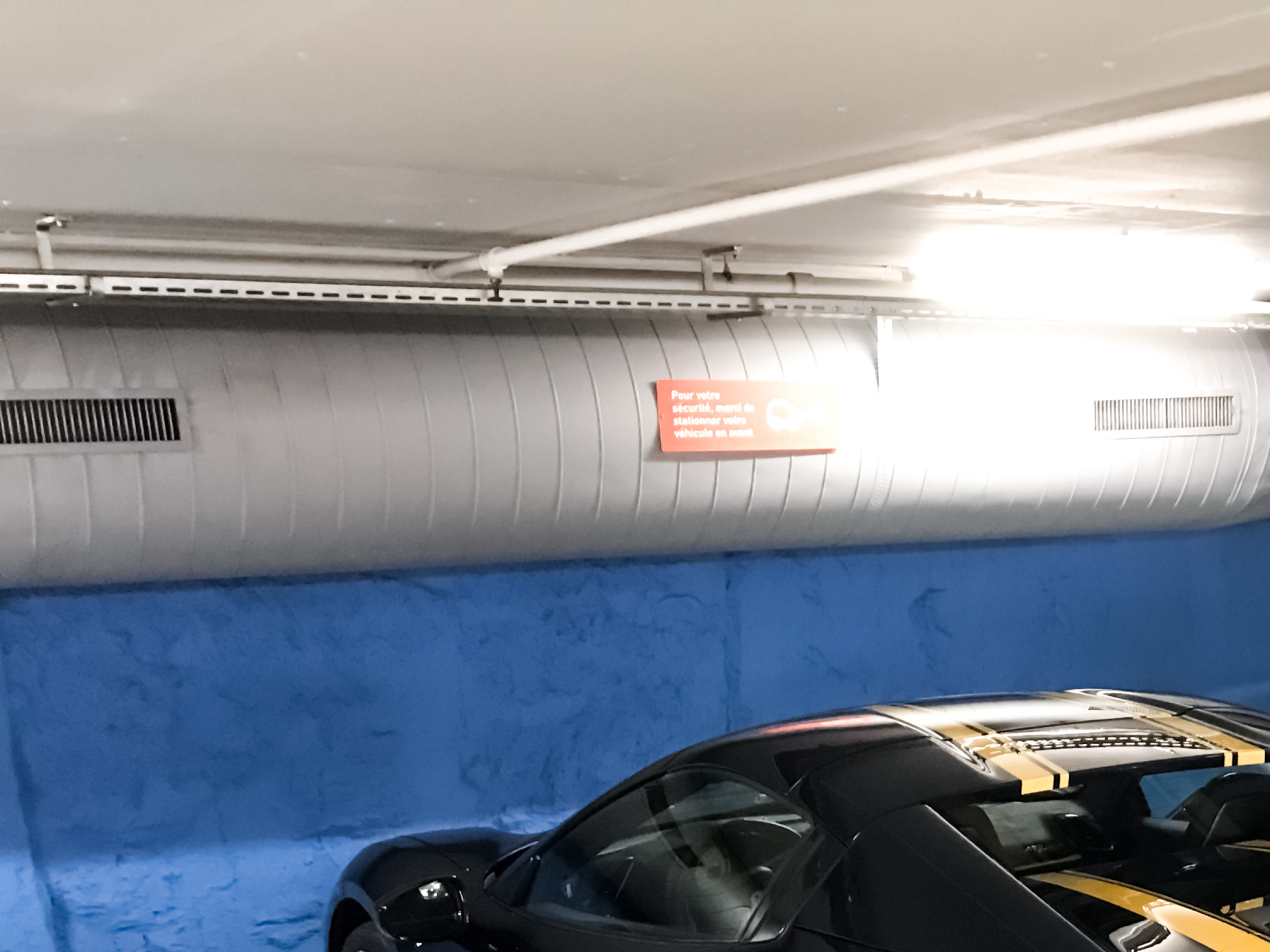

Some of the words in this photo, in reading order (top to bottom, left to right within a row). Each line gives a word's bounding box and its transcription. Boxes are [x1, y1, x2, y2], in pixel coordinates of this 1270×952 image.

[671, 390, 694, 400] Pour
[696, 391, 720, 400] votre
[672, 402, 714, 414] sécurité,
[715, 402, 742, 412] merci
[743, 402, 755, 413] de
[673, 415, 721, 426] stationner
[723, 415, 747, 425] votre
[674, 427, 713, 438] véhicule
[715, 429, 727, 438] en
[729, 428, 754, 438] avant
